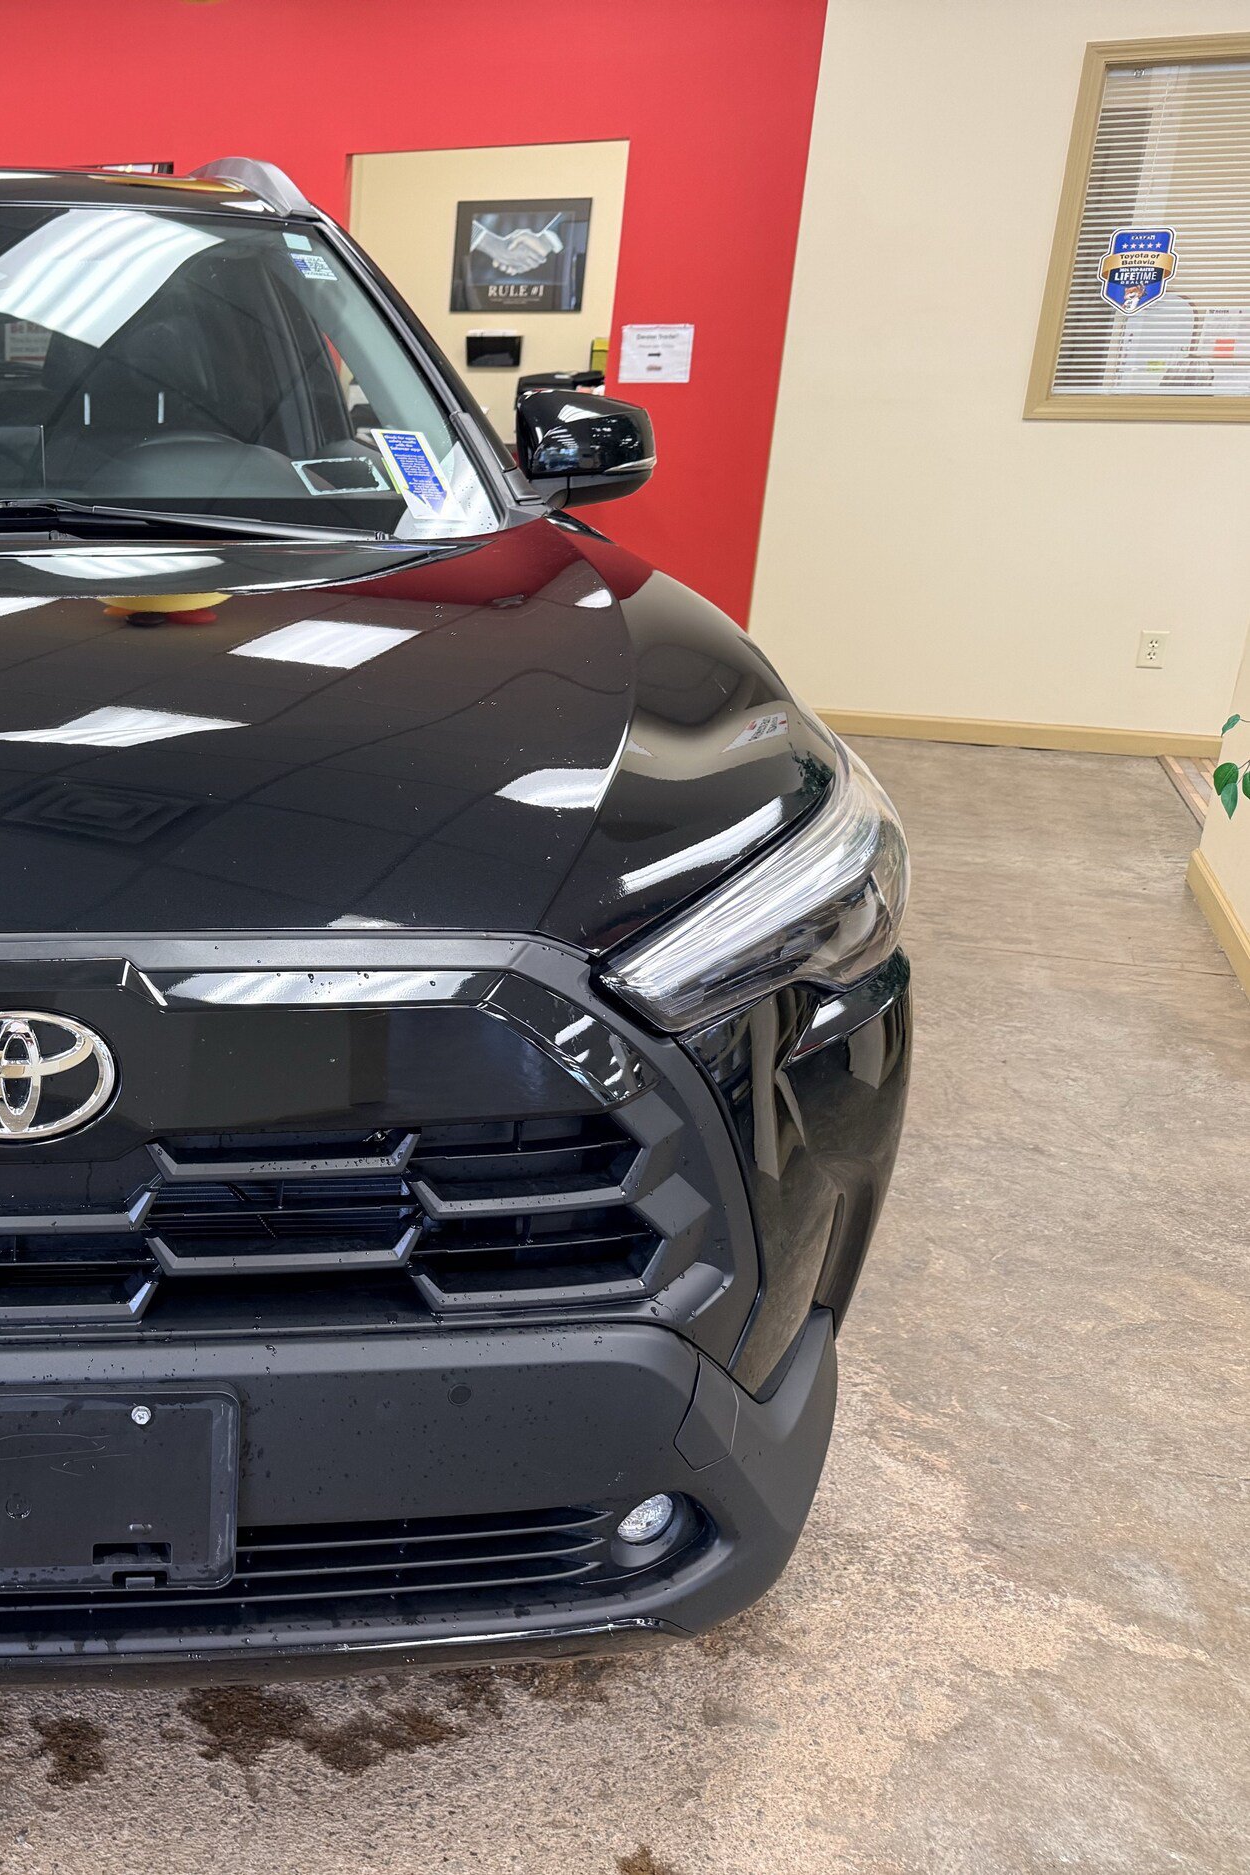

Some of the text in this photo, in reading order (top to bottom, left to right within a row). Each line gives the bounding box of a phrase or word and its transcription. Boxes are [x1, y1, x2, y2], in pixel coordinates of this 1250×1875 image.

[1114, 272, 1157, 280] LIFETIME
[488, 285, 544, 297] RULE #1
